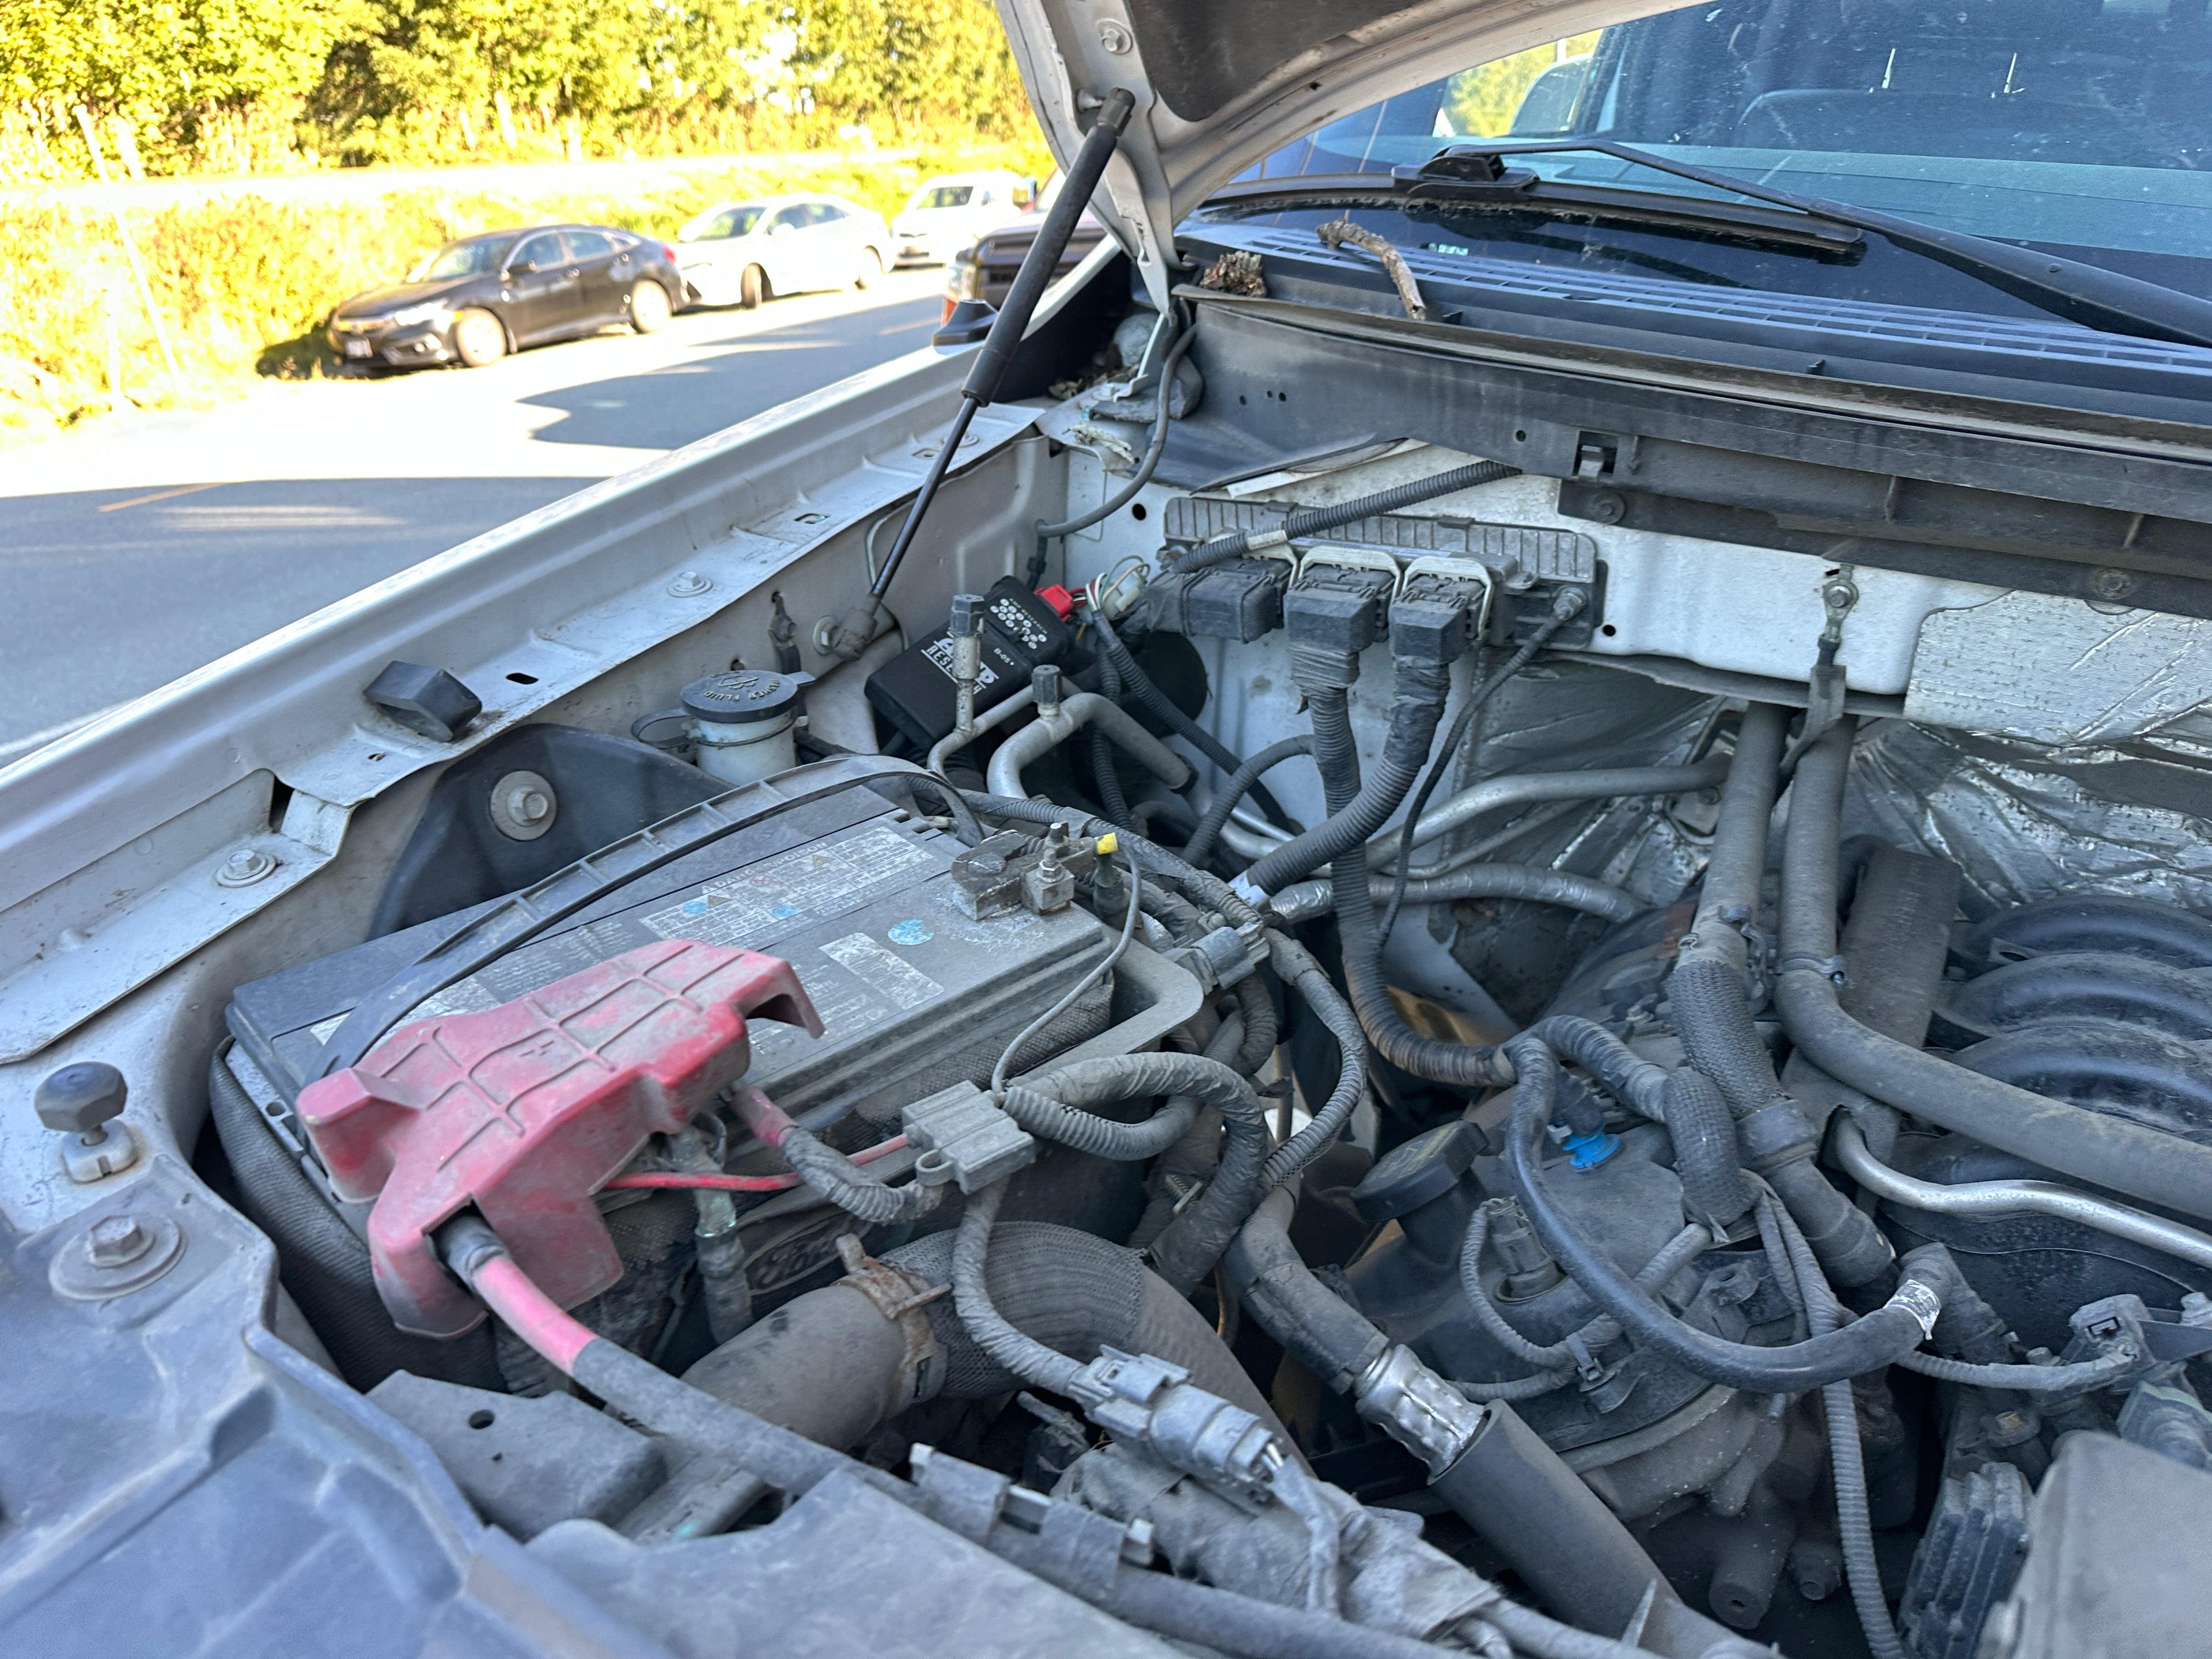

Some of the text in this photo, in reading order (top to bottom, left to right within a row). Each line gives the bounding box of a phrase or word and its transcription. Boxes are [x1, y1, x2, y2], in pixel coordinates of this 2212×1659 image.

[933, 631, 1000, 690] AP
[703, 679, 781, 701] WASHER FLUID
